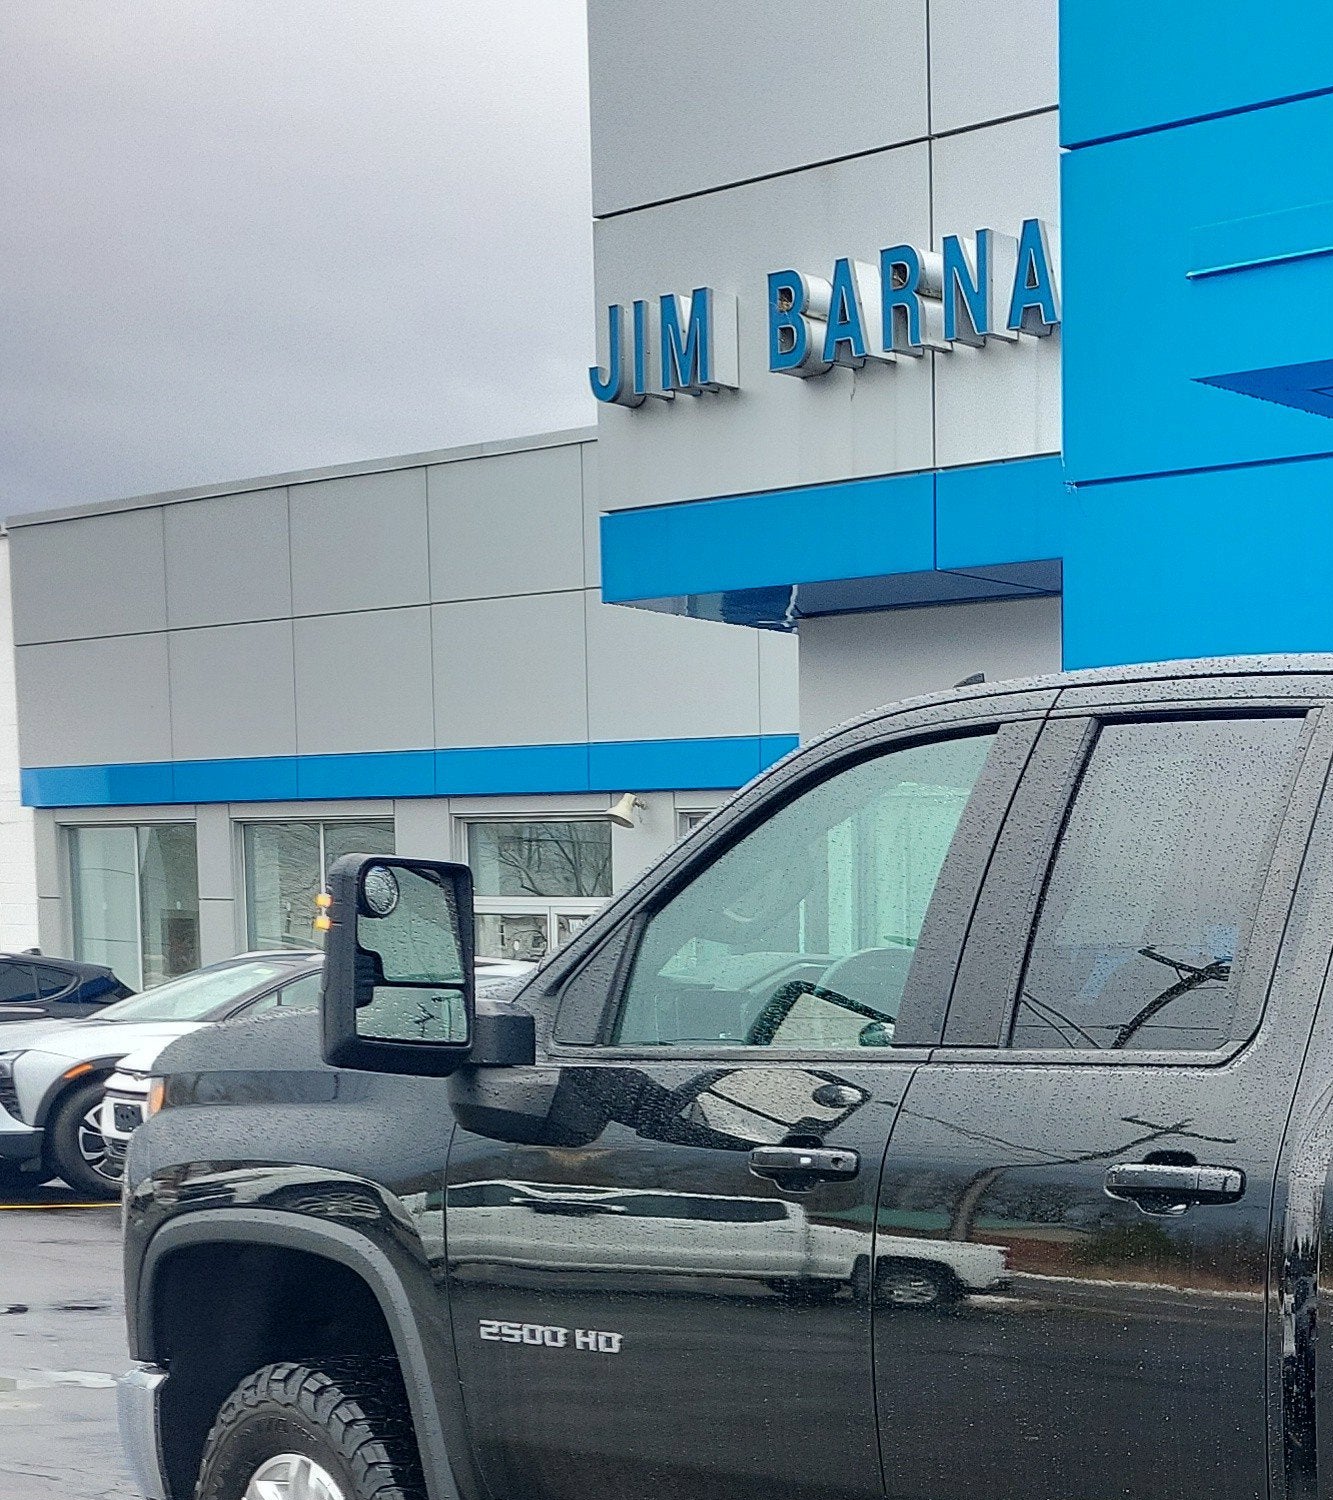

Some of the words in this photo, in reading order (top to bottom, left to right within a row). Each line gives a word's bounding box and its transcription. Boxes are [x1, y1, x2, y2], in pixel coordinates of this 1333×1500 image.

[589, 286, 722, 403] JIM
[767, 218, 1061, 376] BARNA
[479, 1319, 569, 1348] 2500
[574, 1328, 624, 1354] HD
